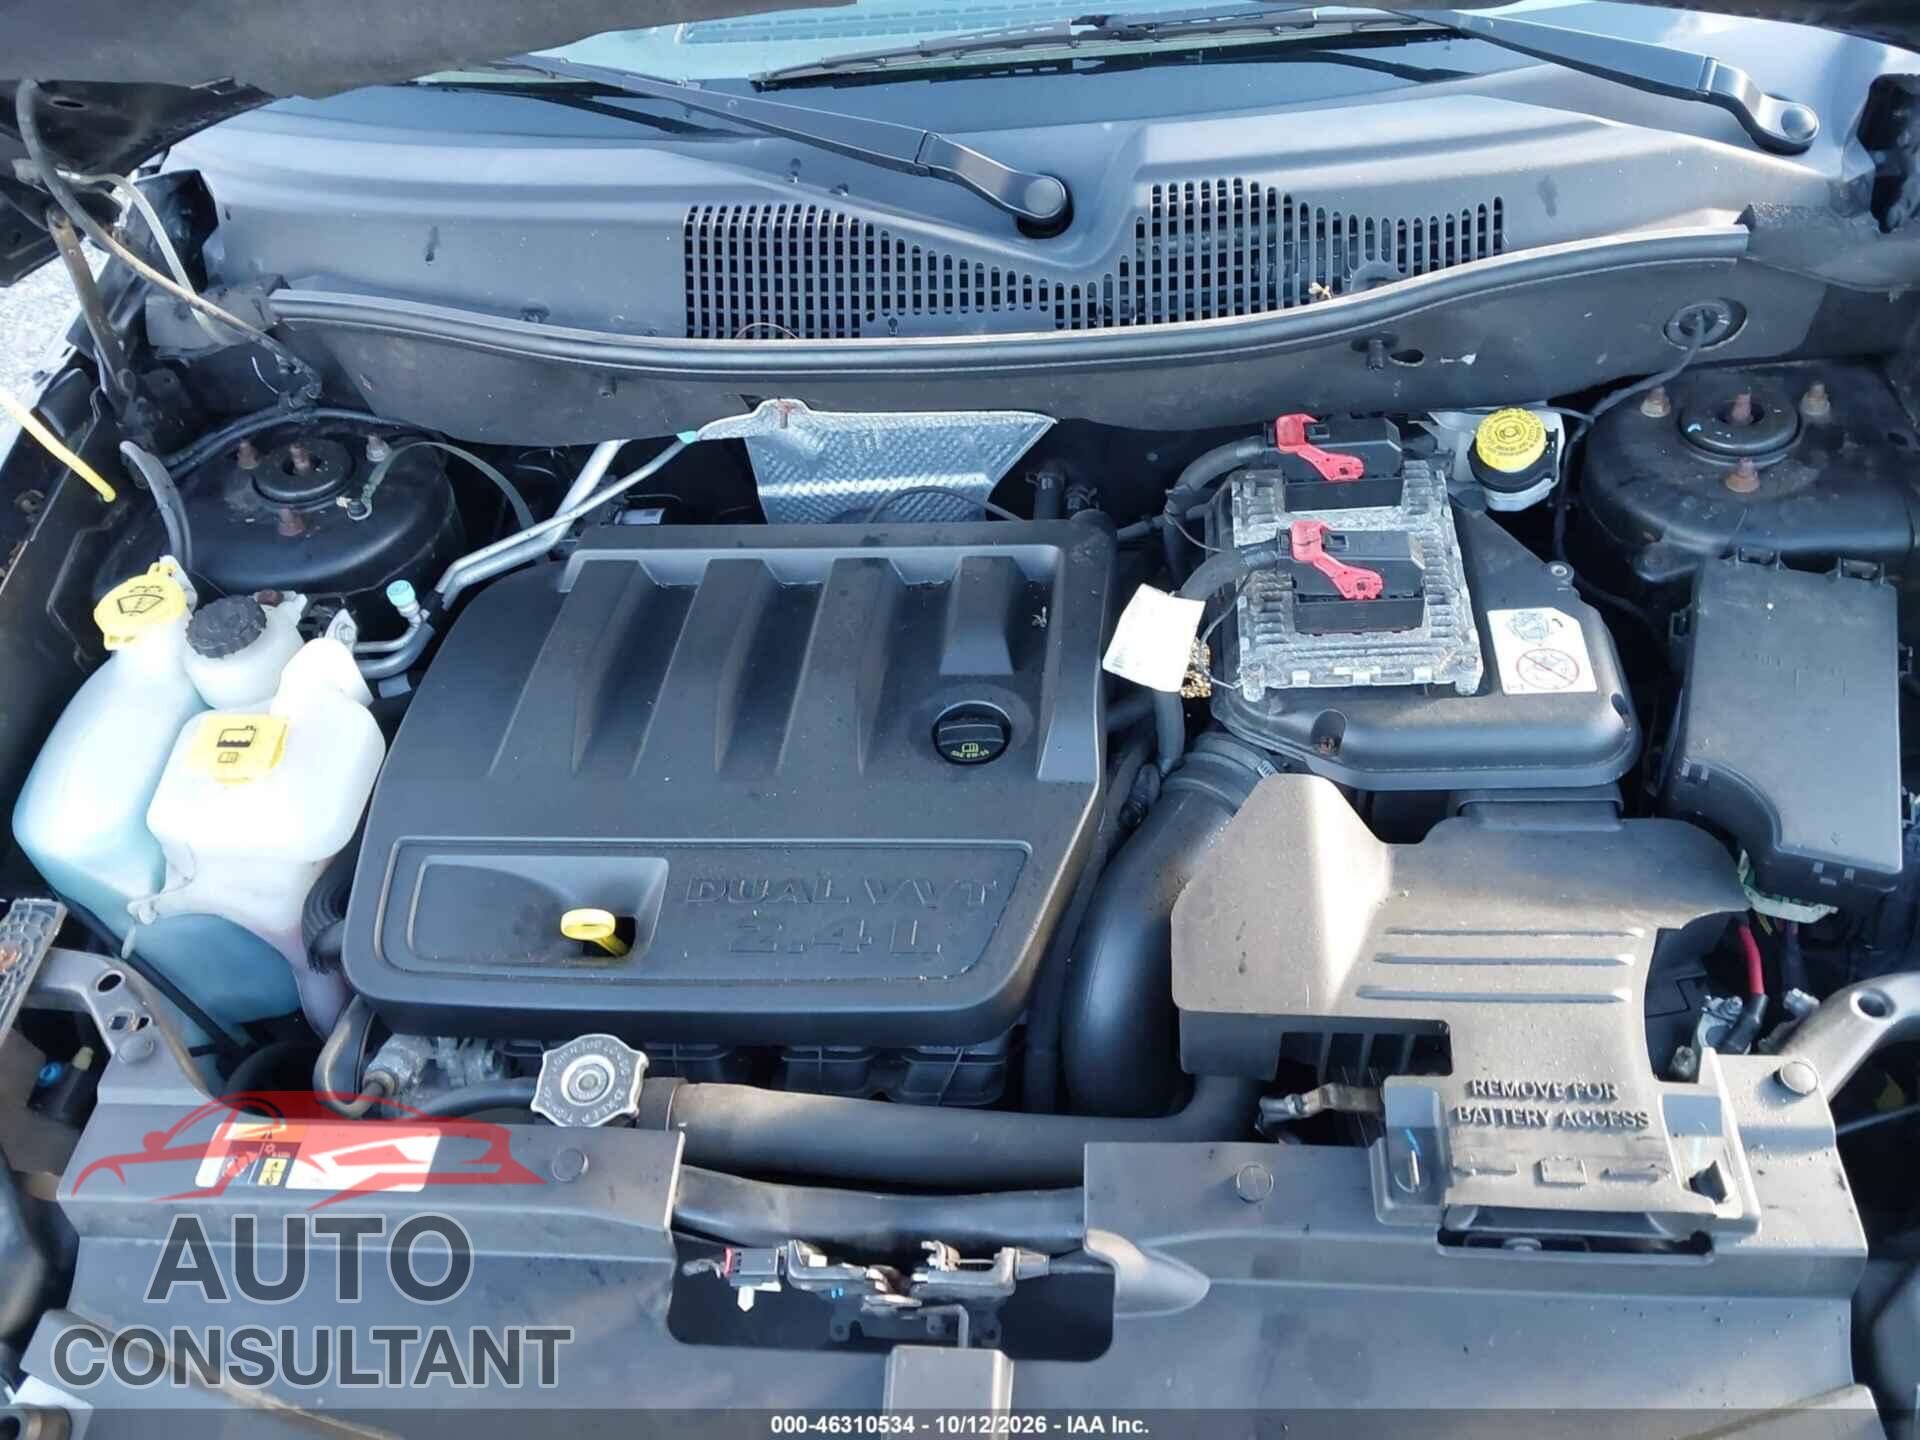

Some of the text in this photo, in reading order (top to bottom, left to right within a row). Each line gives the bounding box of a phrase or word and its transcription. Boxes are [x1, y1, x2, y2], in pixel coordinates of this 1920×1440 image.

[686, 879, 998, 906] DUAL VVT
[728, 917, 943, 955] 2.4L
[1469, 1078, 1619, 1101] REMOVE FOR
[1454, 1104, 1651, 1130] BATTERY ACCESS
